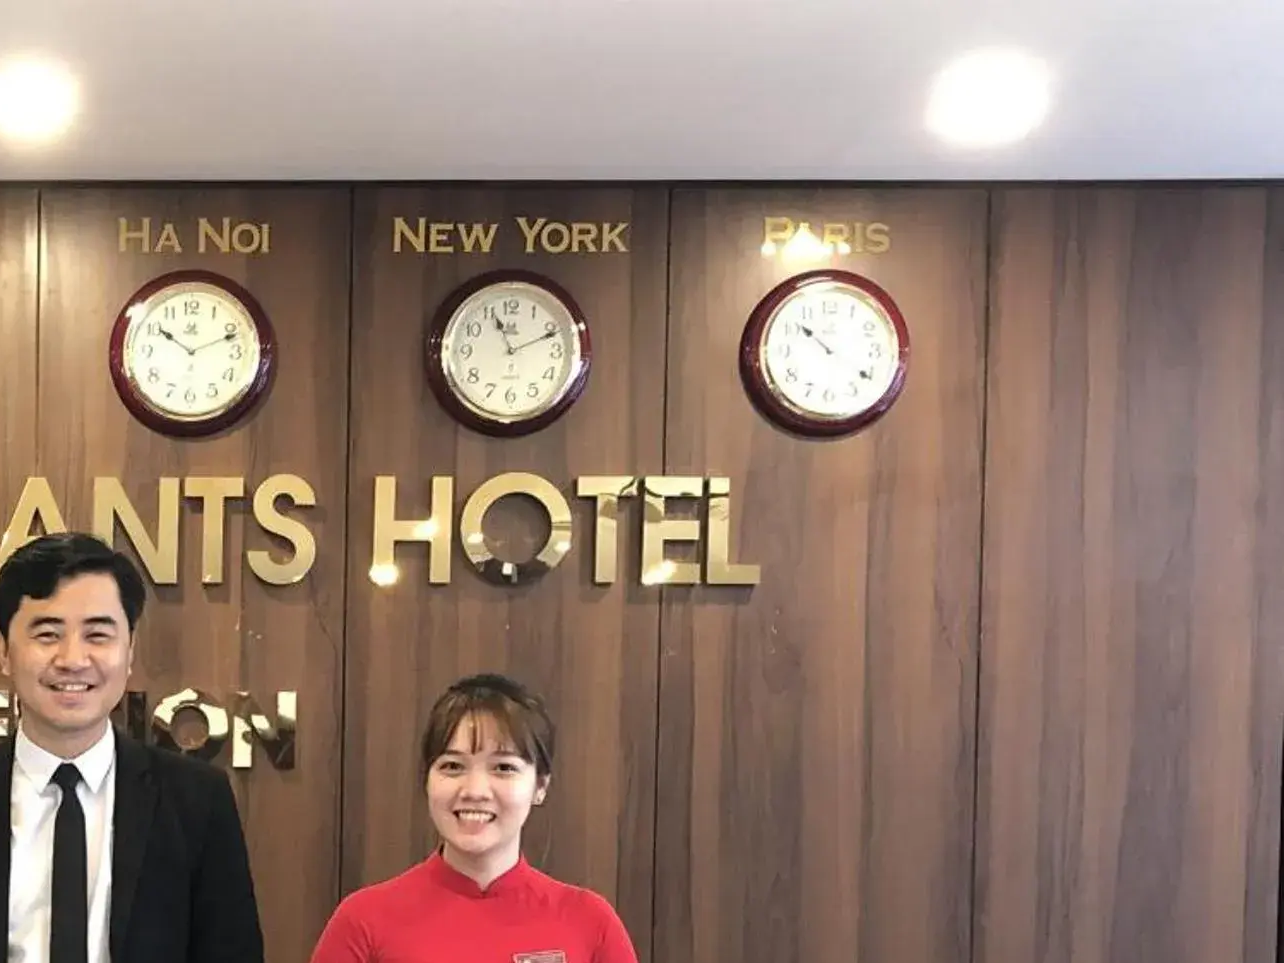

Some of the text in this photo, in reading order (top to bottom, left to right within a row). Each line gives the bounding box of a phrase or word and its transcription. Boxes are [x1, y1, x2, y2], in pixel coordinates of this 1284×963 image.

[118, 217, 270, 254] HA NOI
[392, 216, 630, 254] NEW YORK
[762, 215, 892, 255] PARIS
[164, 305, 176, 321] 11
[183, 300, 200, 316] 12
[502, 299, 520, 316] 12
[466, 321, 482, 338] 10
[141, 344, 154, 359] 9
[228, 344, 242, 361] 3
[459, 343, 473, 360] 9
[549, 343, 563, 360] 3
[147, 367, 161, 384] 8
[221, 367, 235, 382] 4
[466, 367, 480, 384] 8
[541, 365, 556, 381] 4
[165, 382, 177, 399] 7
[183, 387, 196, 403] 6
[206, 382, 219, 399] 5
[484, 382, 497, 399] 7
[504, 386, 517, 404] 6
[526, 382, 539, 398] 5
[370, 472, 761, 586] HOTEL
